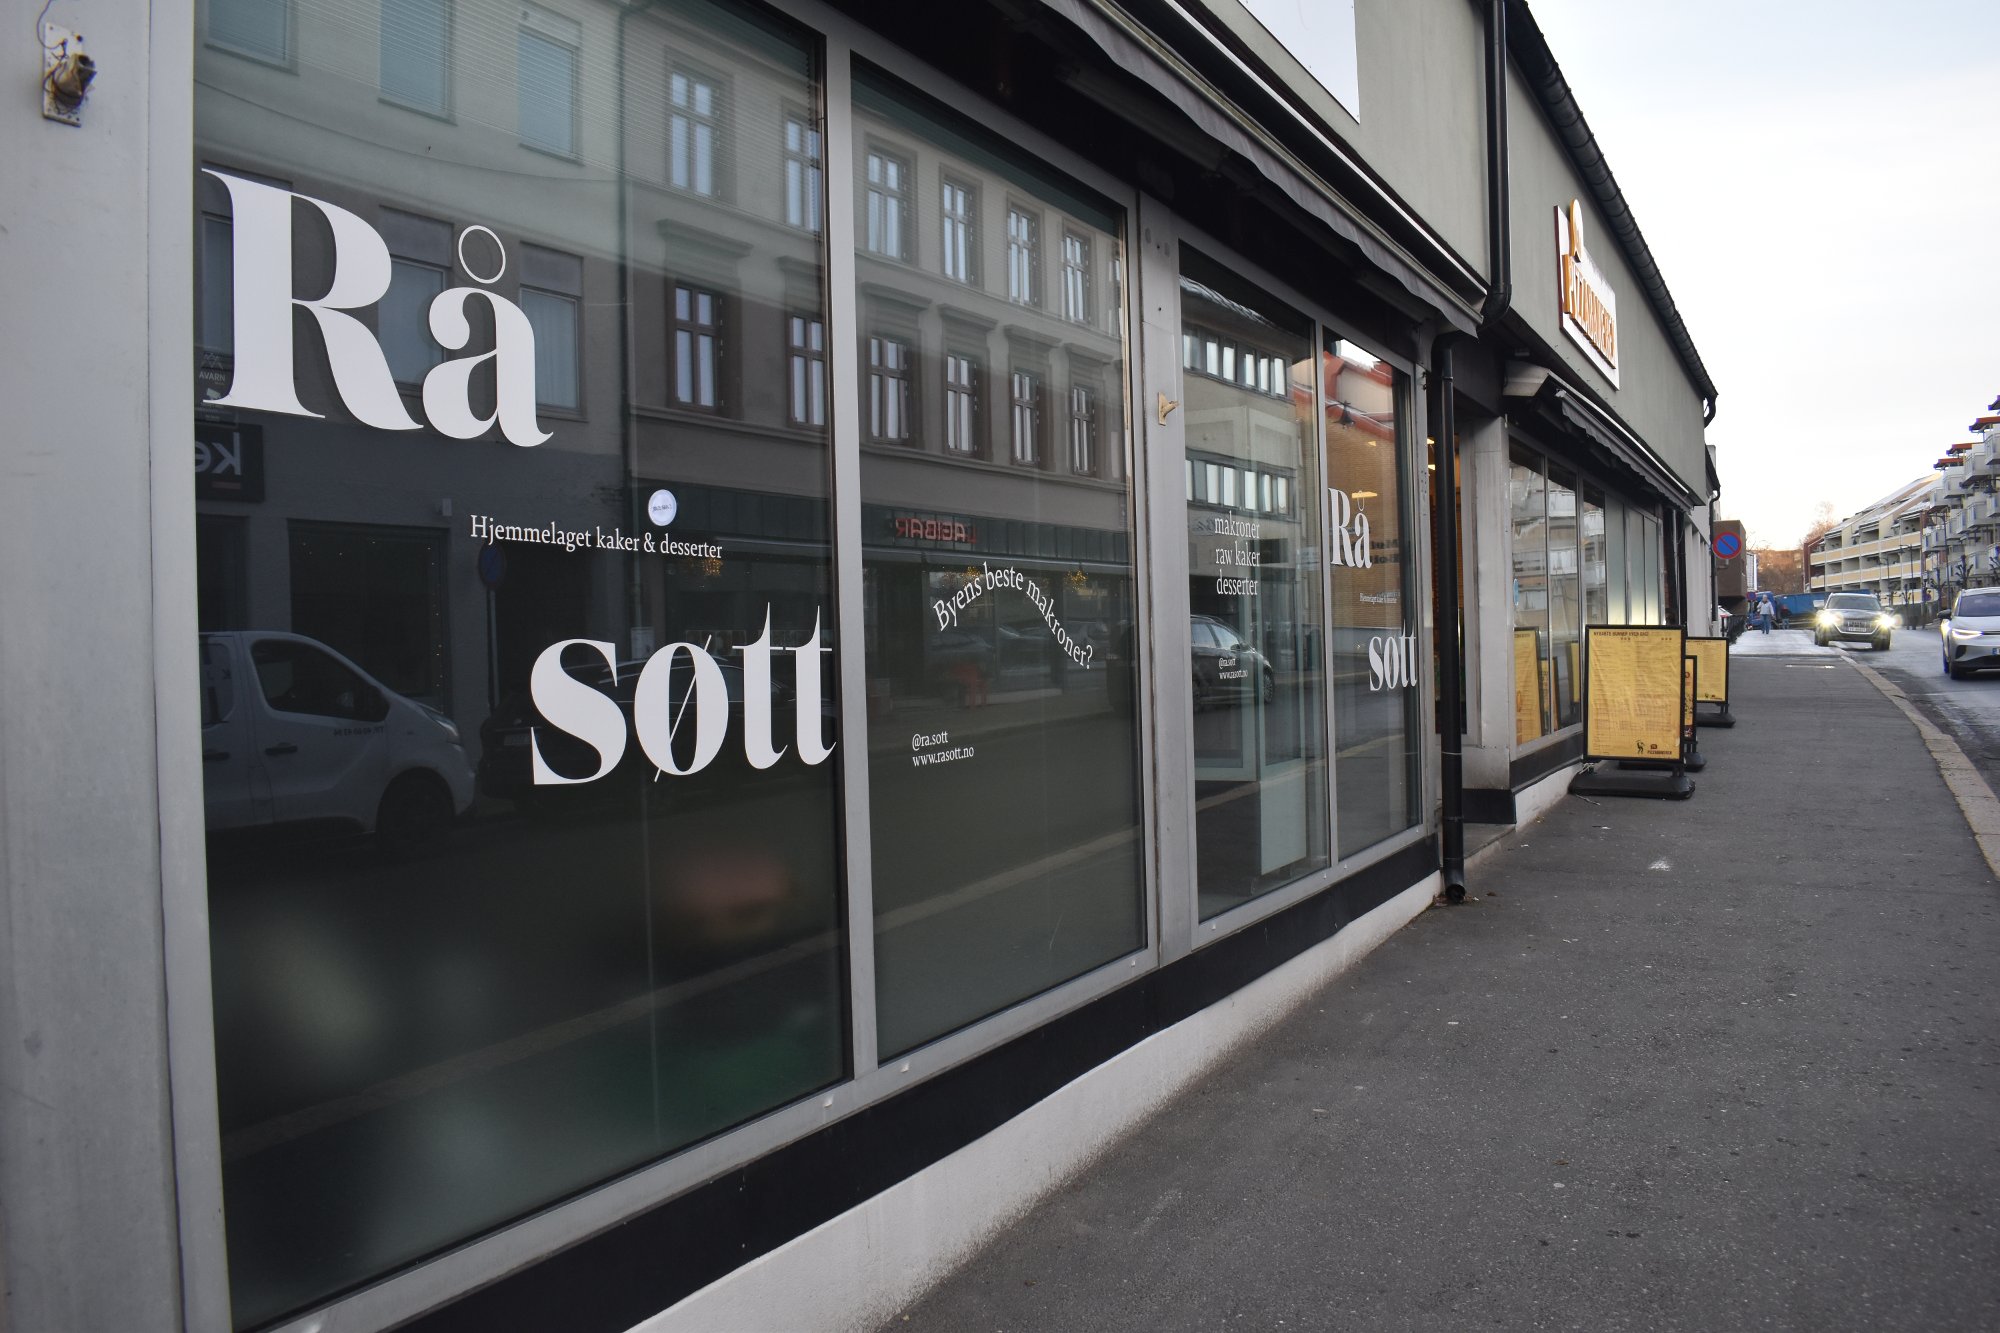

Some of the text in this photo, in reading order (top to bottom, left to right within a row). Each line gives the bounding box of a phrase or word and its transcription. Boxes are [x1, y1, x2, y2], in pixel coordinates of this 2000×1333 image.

[201, 168, 554, 448] Rå
[199, 371, 226, 382] AVARN
[470, 514, 723, 559] Hjemmelaget kaker & desserter
[1214, 511, 1260, 540] makroner
[1215, 541, 1261, 567] raw kaker
[1216, 569, 1258, 596] desserter
[933, 561, 1094, 670] Byens beste makroner?
[530, 602, 837, 785] søtt
[912, 731, 949, 751] @ra.sott
[912, 747, 975, 767] www.rasott.no
